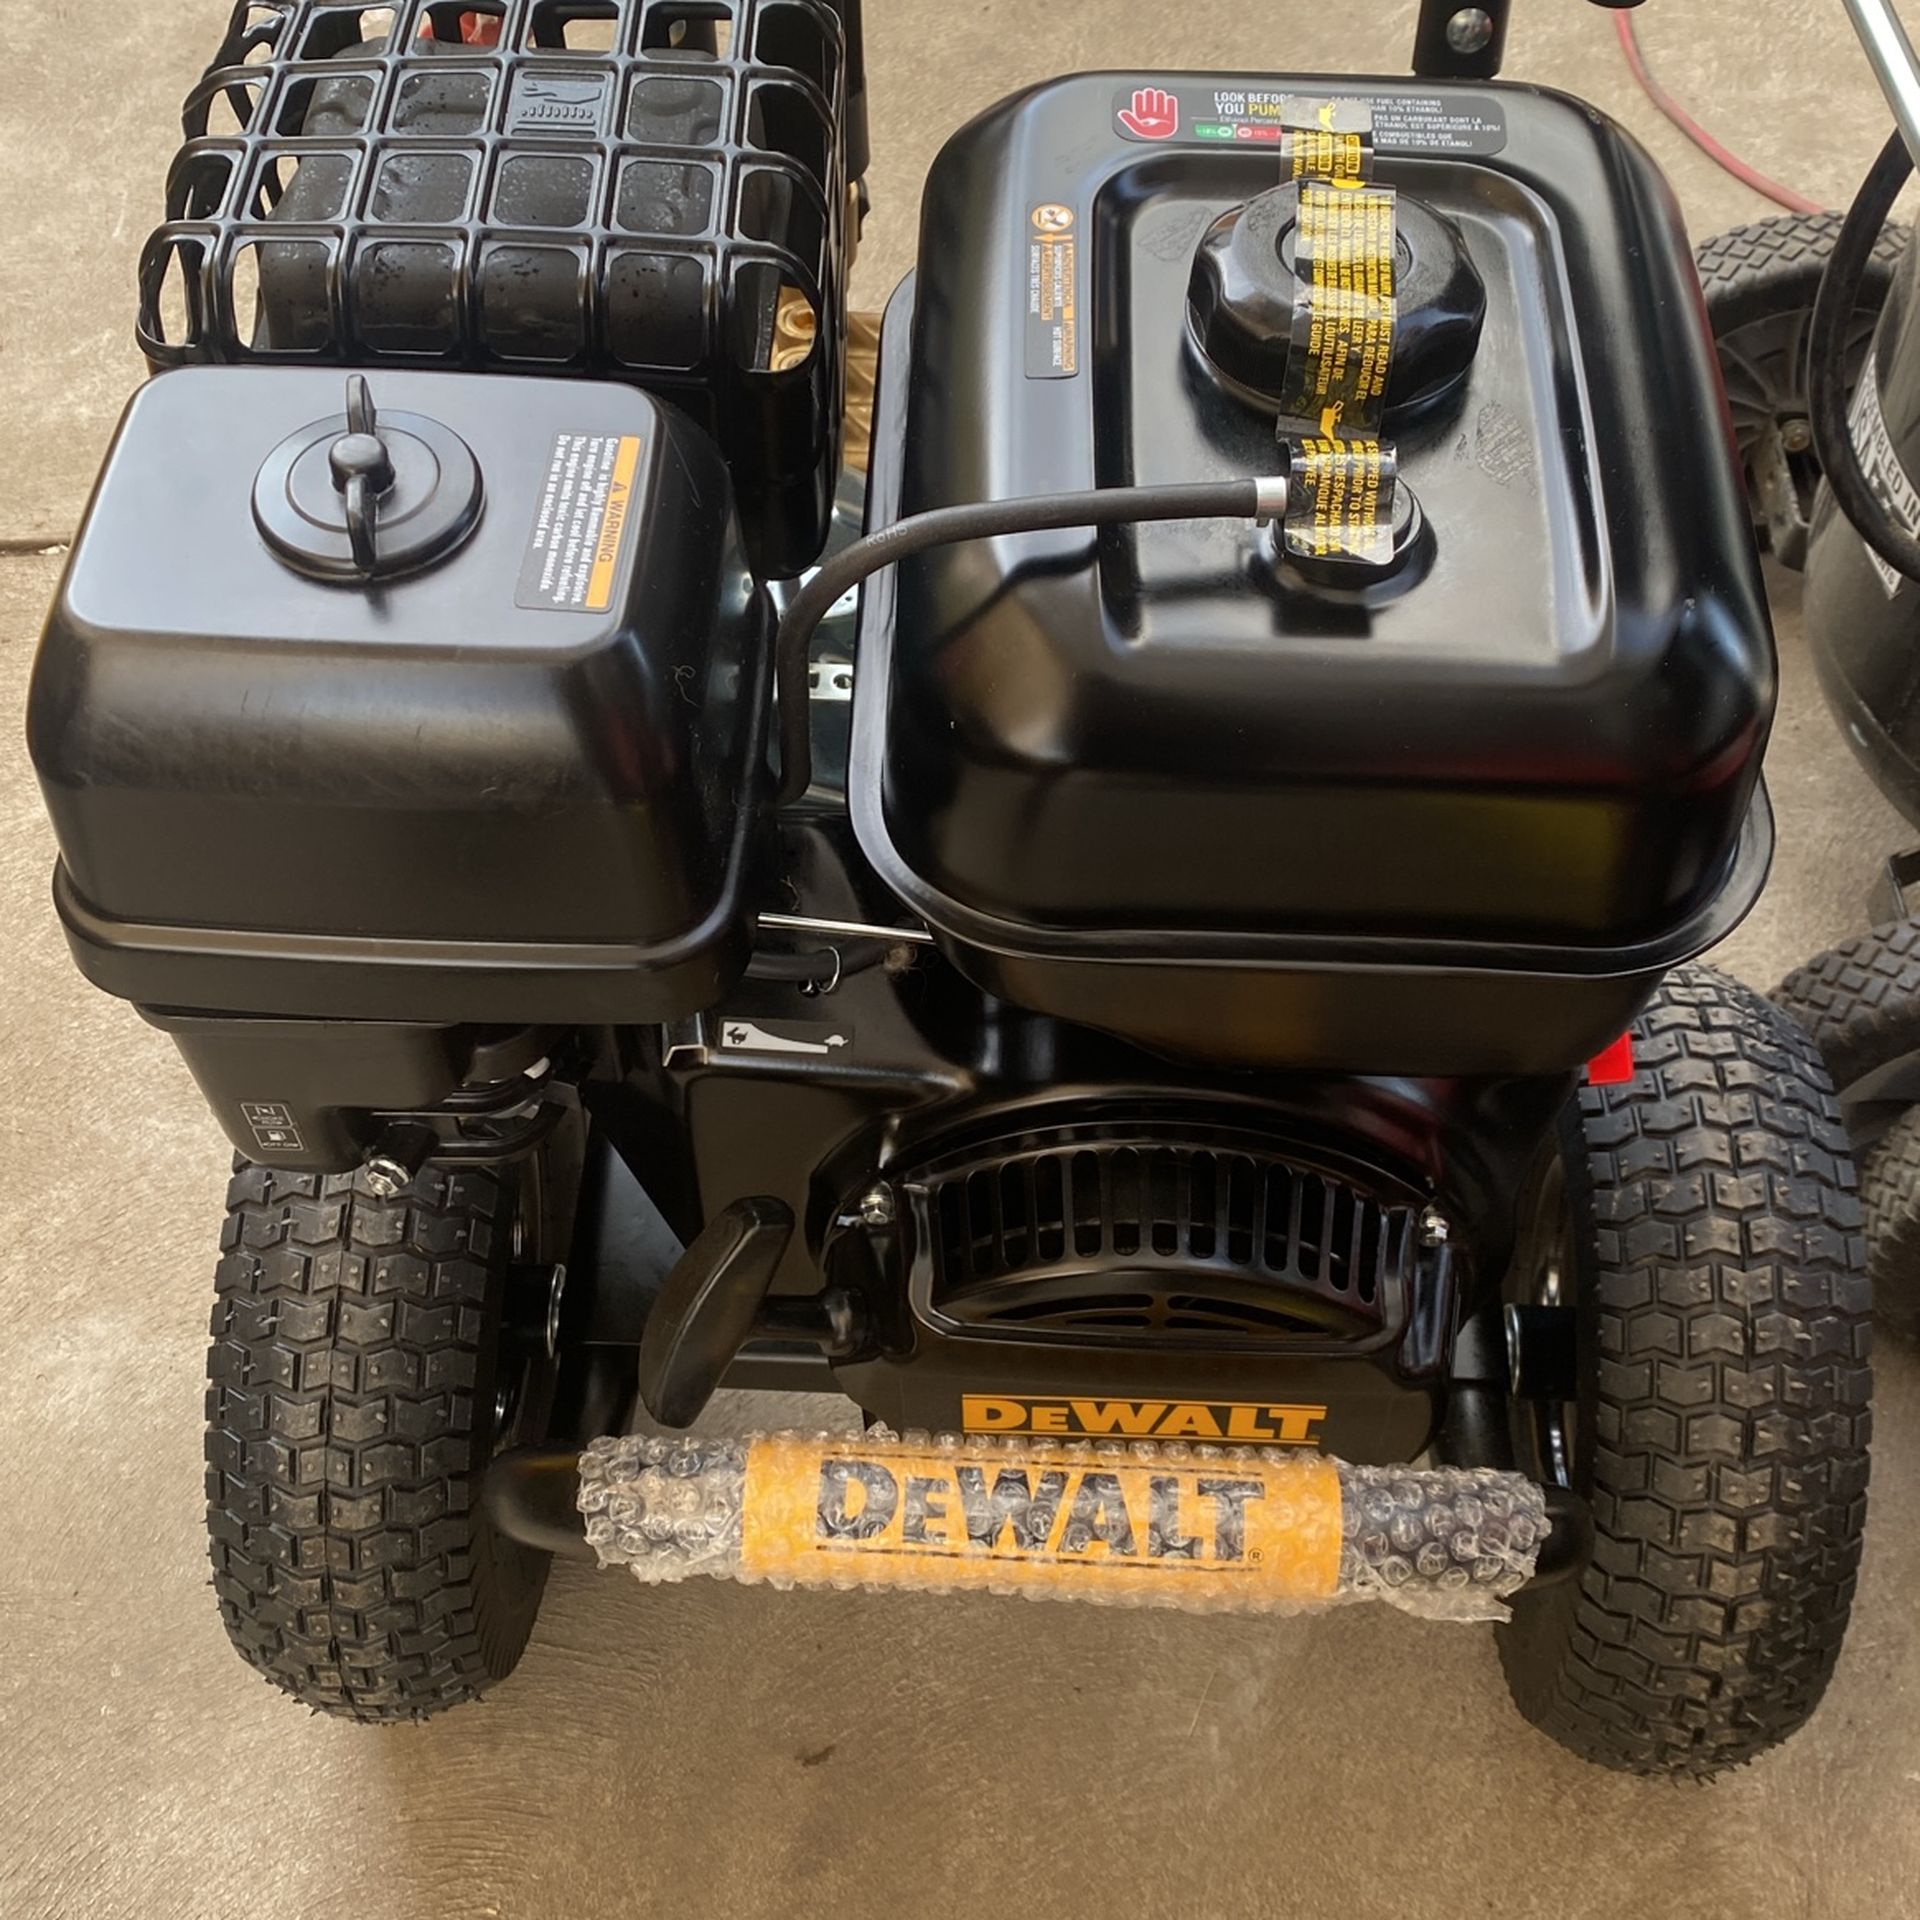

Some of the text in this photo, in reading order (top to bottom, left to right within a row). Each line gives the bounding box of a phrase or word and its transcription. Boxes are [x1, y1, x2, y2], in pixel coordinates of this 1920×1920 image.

[1213, 91, 1295, 104] LOOK BEFOR
[1215, 103, 1281, 116] YOU PUM
[1308, 323, 1322, 355] GUIDE
[1351, 320, 1364, 343] LEER
[1364, 319, 1378, 343] PARA
[1374, 345, 1389, 373] READ
[557, 434, 569, 444] Do
[554, 446, 566, 458] not
[600, 437, 617, 470] Gasoline
[590, 481, 608, 505] highly
[1349, 495, 1361, 510] TO
[537, 493, 555, 528] enclosed
[539, 435, 586, 592] This engine emits toxic carbon monoxide.
[551, 436, 602, 604] Turn engine off and let cool before refueling.
[532, 529, 546, 549] area.
[598, 499, 623, 563] WARNING
[866, 521, 908, 548] RoHS
[580, 547, 594, 562] and
[963, 1397, 1327, 1441] DEWALT
[815, 1458, 1265, 1562] DEWALT
